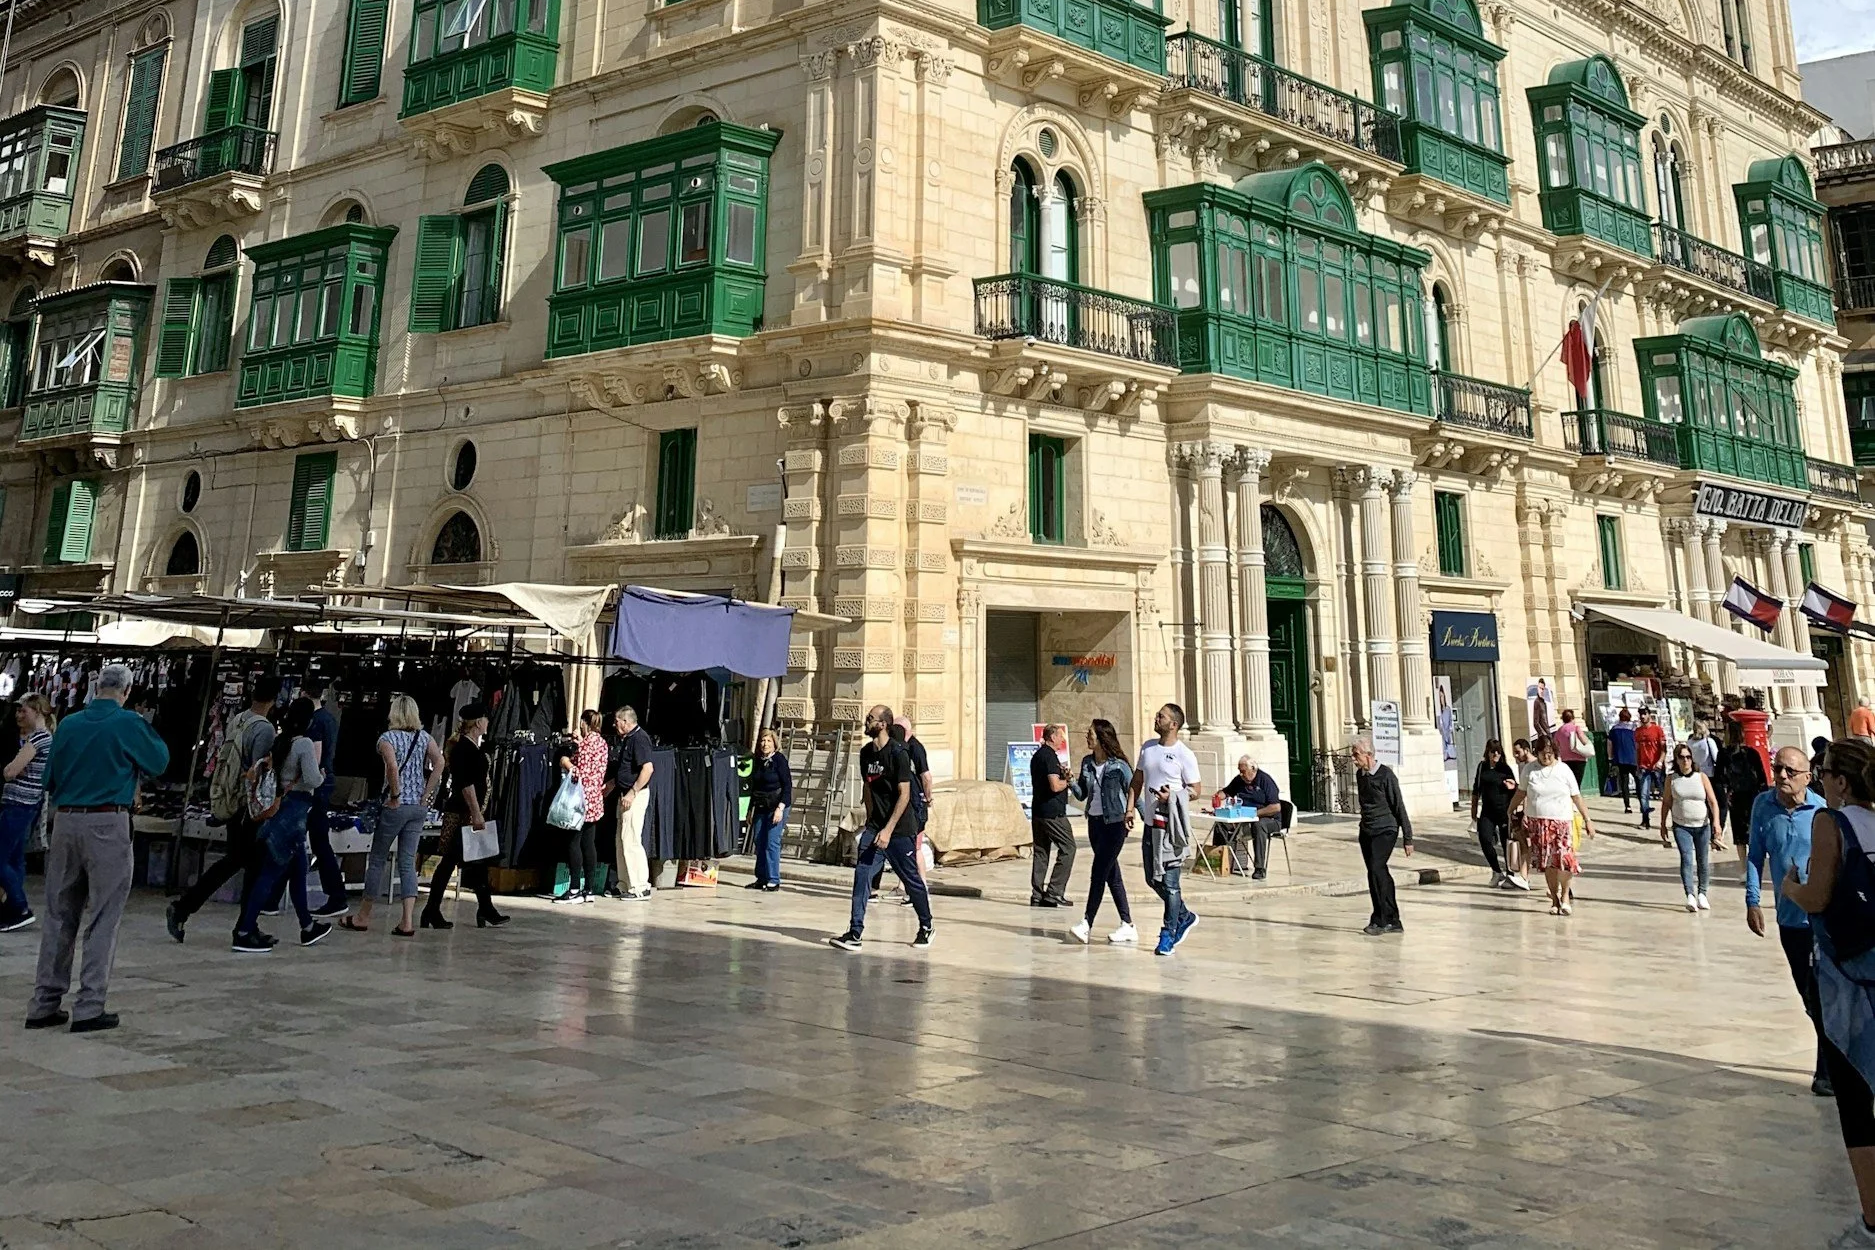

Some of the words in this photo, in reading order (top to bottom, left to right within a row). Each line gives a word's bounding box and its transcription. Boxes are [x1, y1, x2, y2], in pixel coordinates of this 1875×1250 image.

[1725, 491, 1768, 521] BATTA
[1767, 499, 1805, 527] DELIA
[1014, 749, 1037, 759] SICILY
